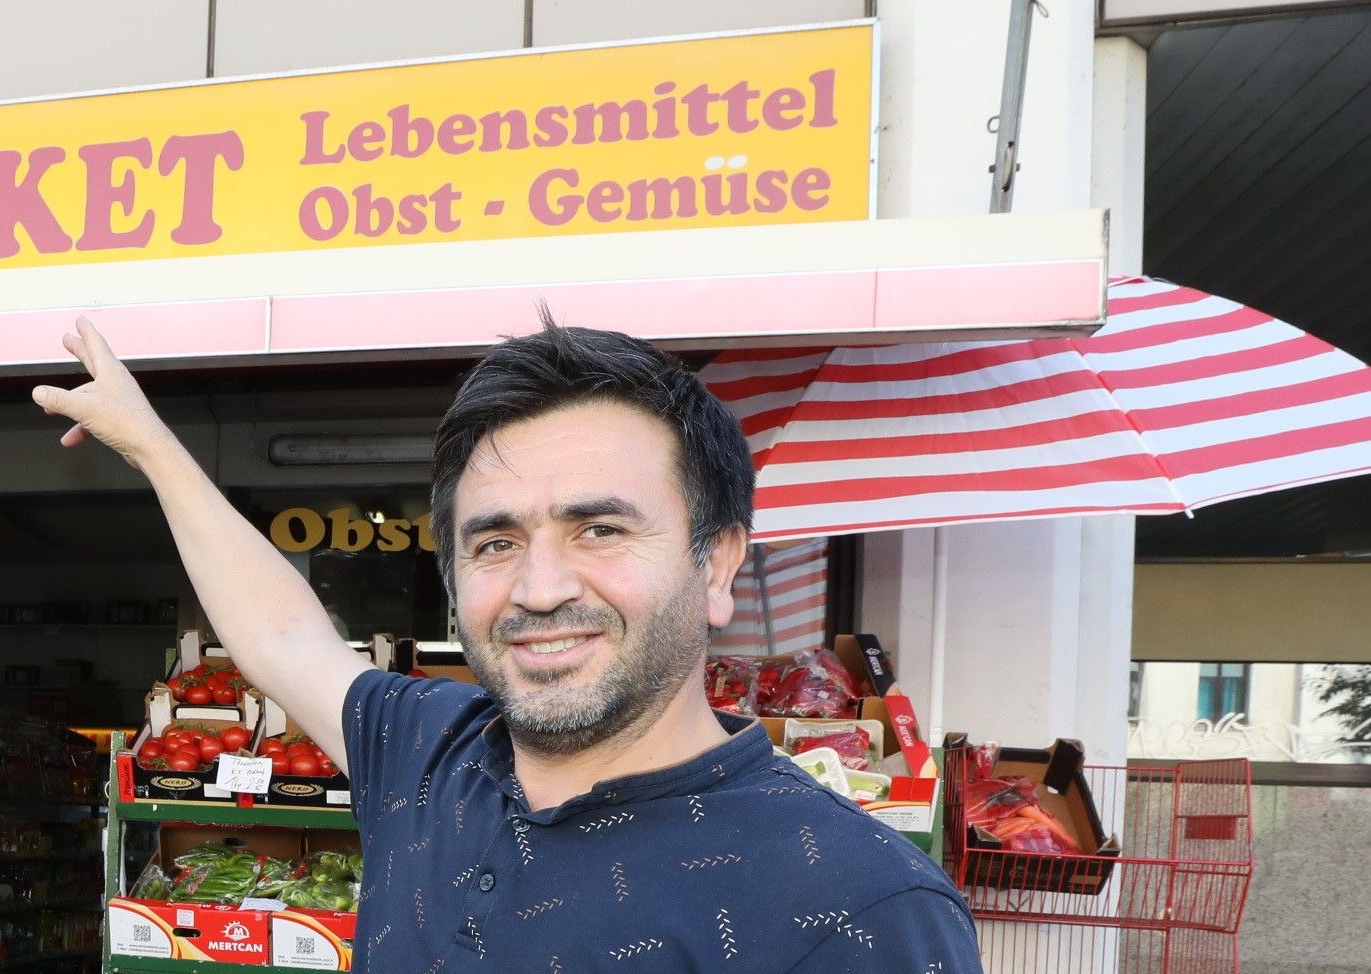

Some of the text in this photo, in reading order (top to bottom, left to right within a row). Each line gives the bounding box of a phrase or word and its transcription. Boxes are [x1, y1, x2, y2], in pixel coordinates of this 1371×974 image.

[299, 68, 838, 166] Lebensmittel
[299, 183, 462, 241] Obst
[529, 155, 831, 226] Gemüse
[208, 941, 263, 952] MERTCAN
